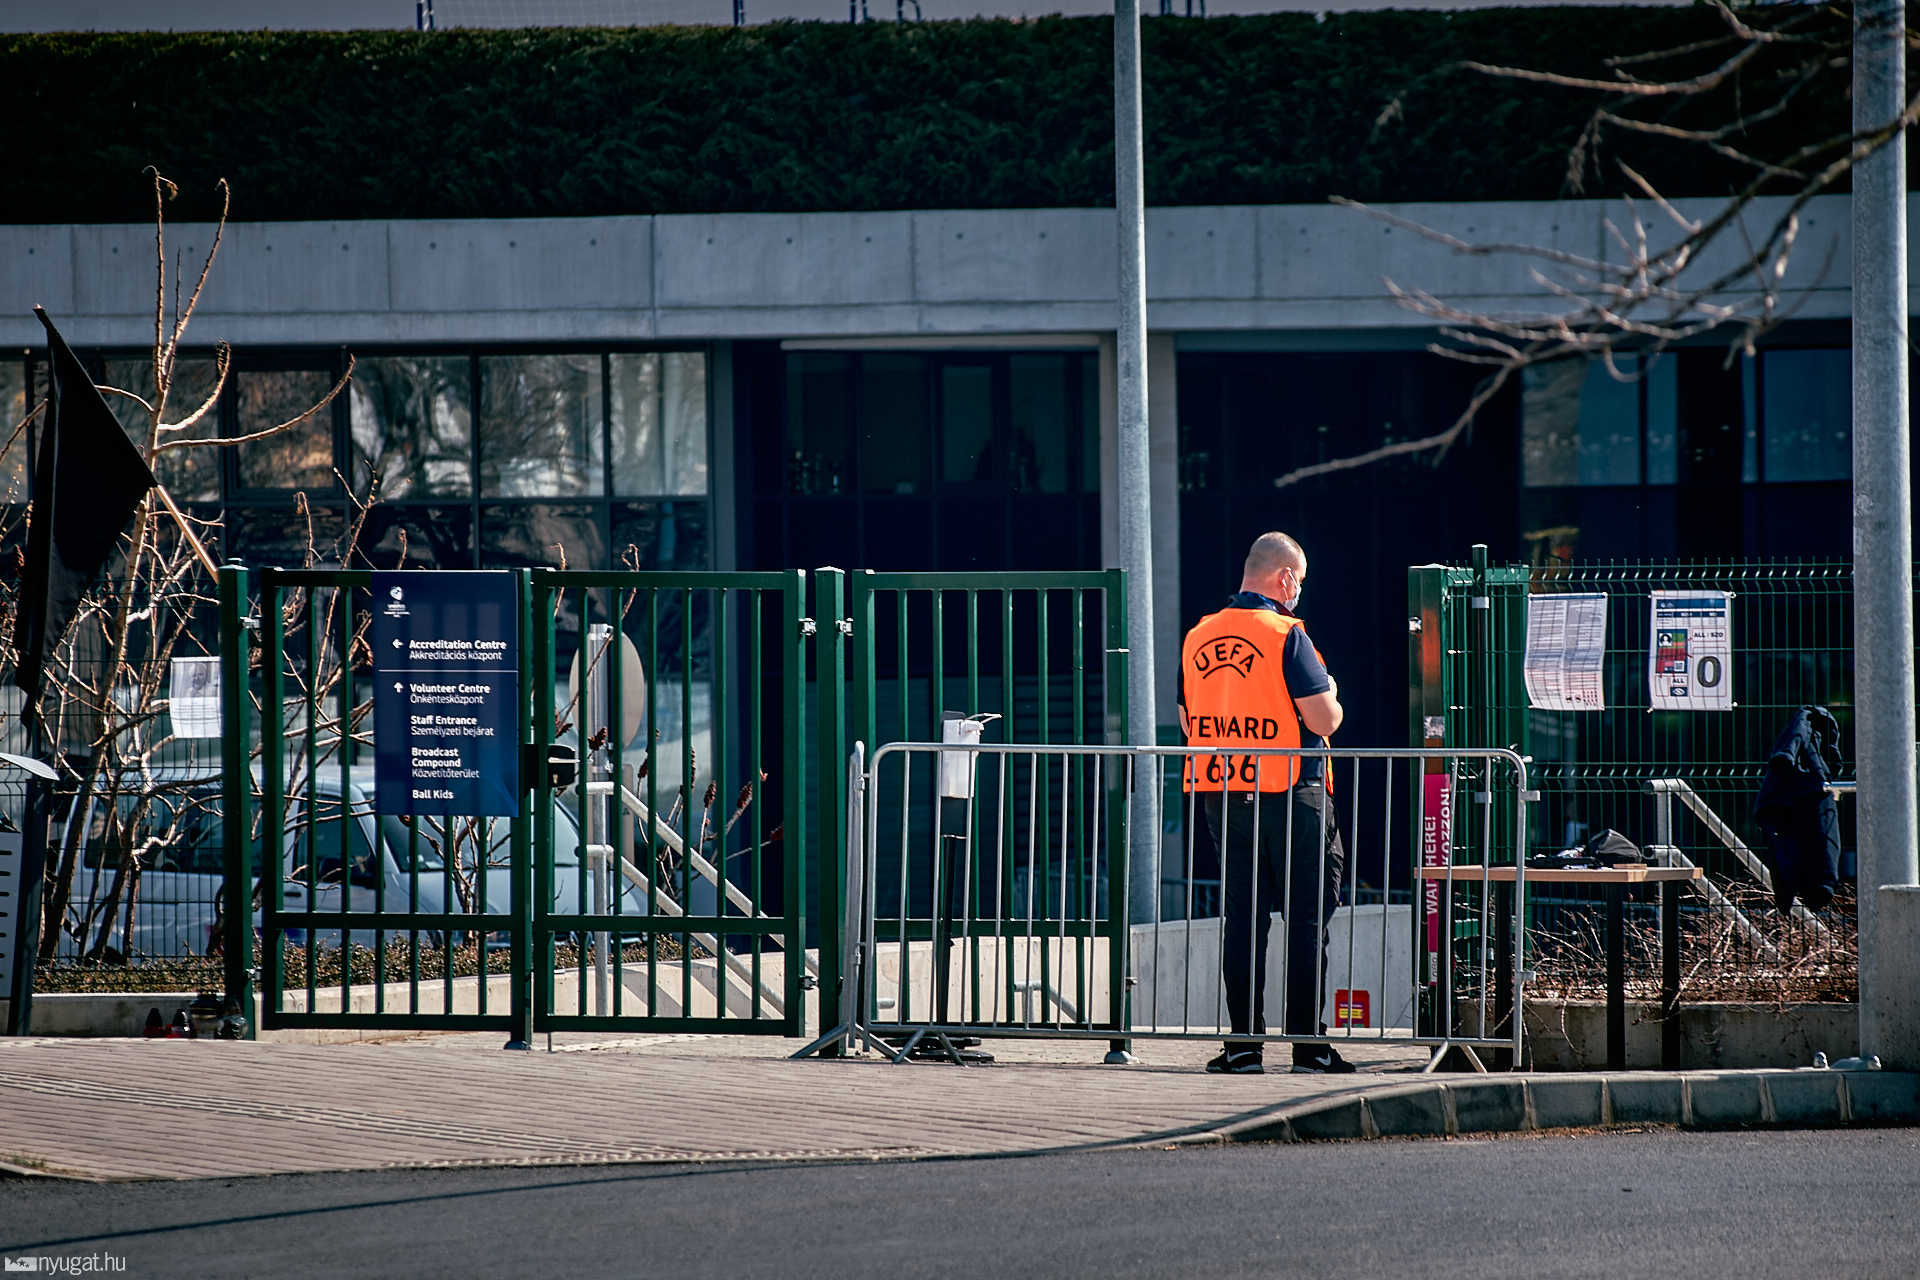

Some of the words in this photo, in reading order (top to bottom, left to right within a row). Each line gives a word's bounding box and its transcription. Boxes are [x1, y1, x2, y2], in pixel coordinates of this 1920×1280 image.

[409, 640, 472, 650] Accreditation
[474, 640, 507, 650] Centre
[409, 650, 466, 660] Akkreditációs
[468, 650, 502, 662] központ
[1195, 642, 1255, 672] UEFA
[410, 683, 457, 693] Volunteer
[458, 684, 491, 694] Centre
[411, 715, 434, 725] Staff
[435, 716, 477, 725] Entrance
[411, 725, 461, 738] Személyzeti
[463, 726, 495, 738] bejárat
[1189, 716, 1278, 739] TEWARD
[411, 747, 459, 757] Broadcast
[412, 758, 461, 769] Compound
[412, 789, 432, 799] Ball
[433, 790, 454, 799] Kids
[1425, 816, 1437, 867] HERE!
[1426, 878, 1438, 915] WAI
